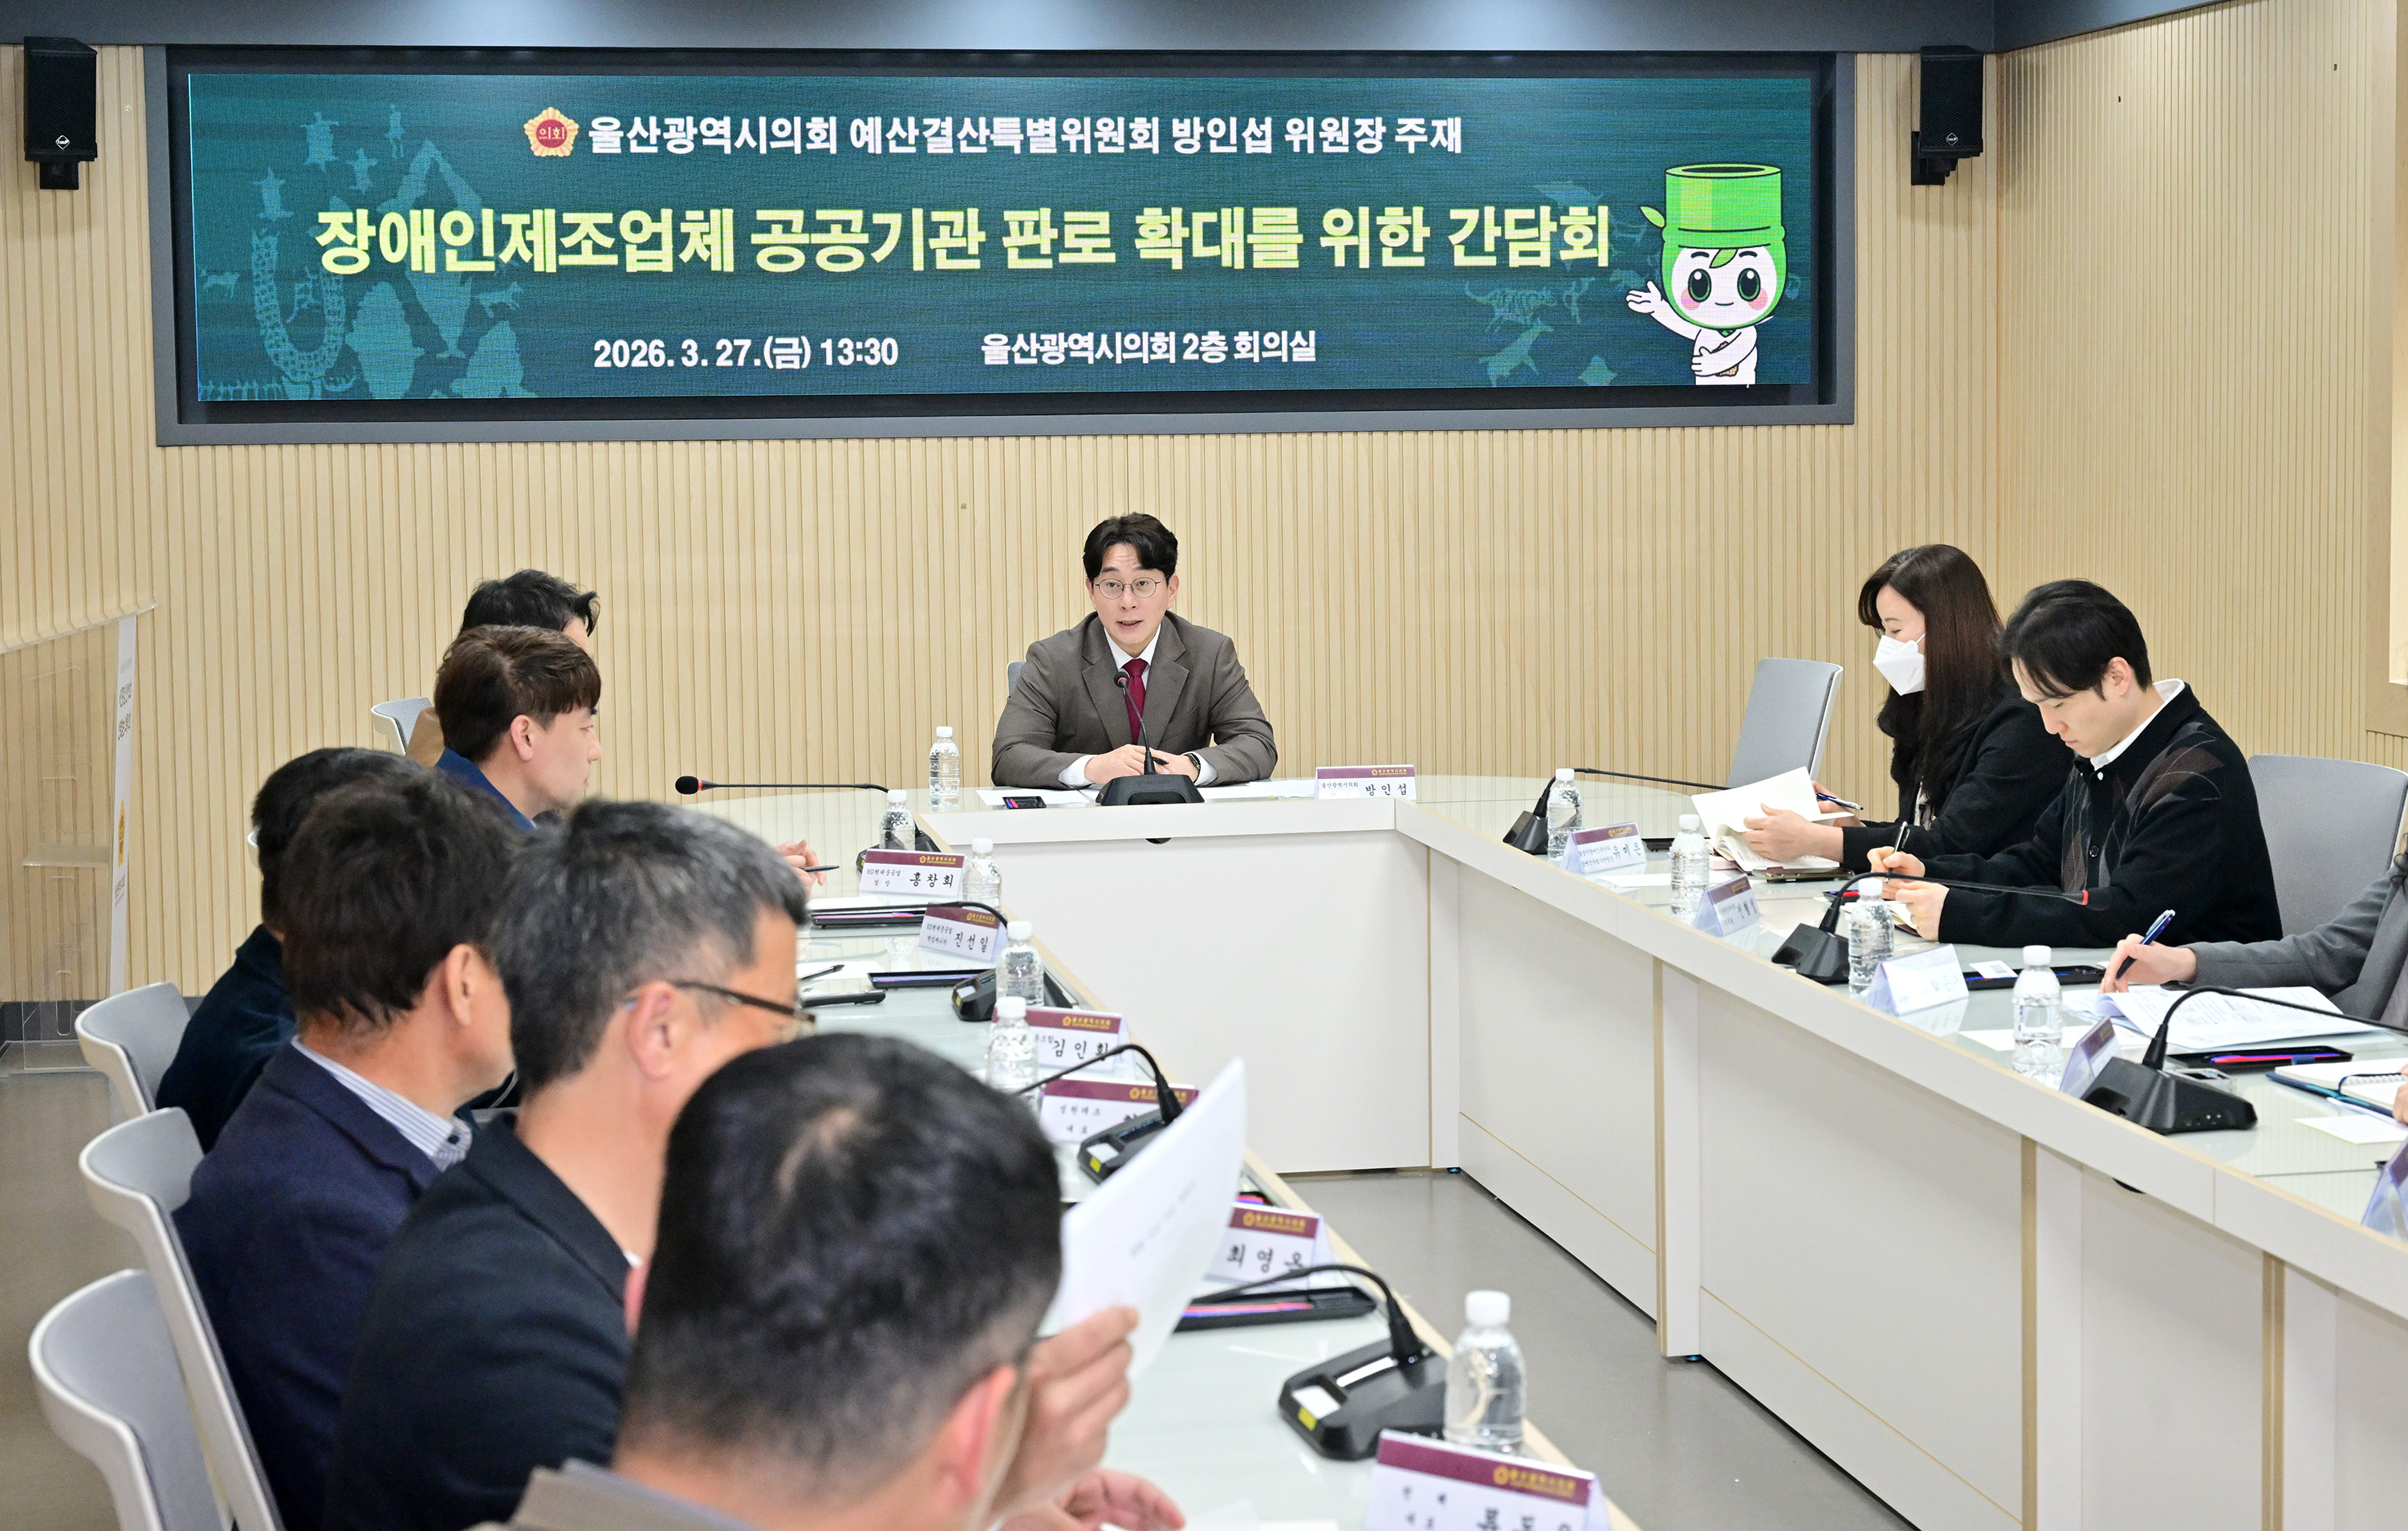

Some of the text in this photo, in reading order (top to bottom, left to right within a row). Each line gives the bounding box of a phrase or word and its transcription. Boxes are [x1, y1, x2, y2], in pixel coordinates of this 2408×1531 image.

[538, 126, 566, 140] 의회
[589, 116, 1462, 155] 울산광역시의회 예산결산특별위원회 방인섭 위원장 주재
[315, 206, 1610, 275] 장애인제조업체 공공기관 판로 확대를 위한 간담회
[595, 336, 899, 370] 2026. 3. 27.(금) 13:30
[982, 331, 1317, 366] 울산광역시의회 2층 회의실
[1365, 784, 1407, 796] 방인섭
[954, 931, 988, 953] 진선일
